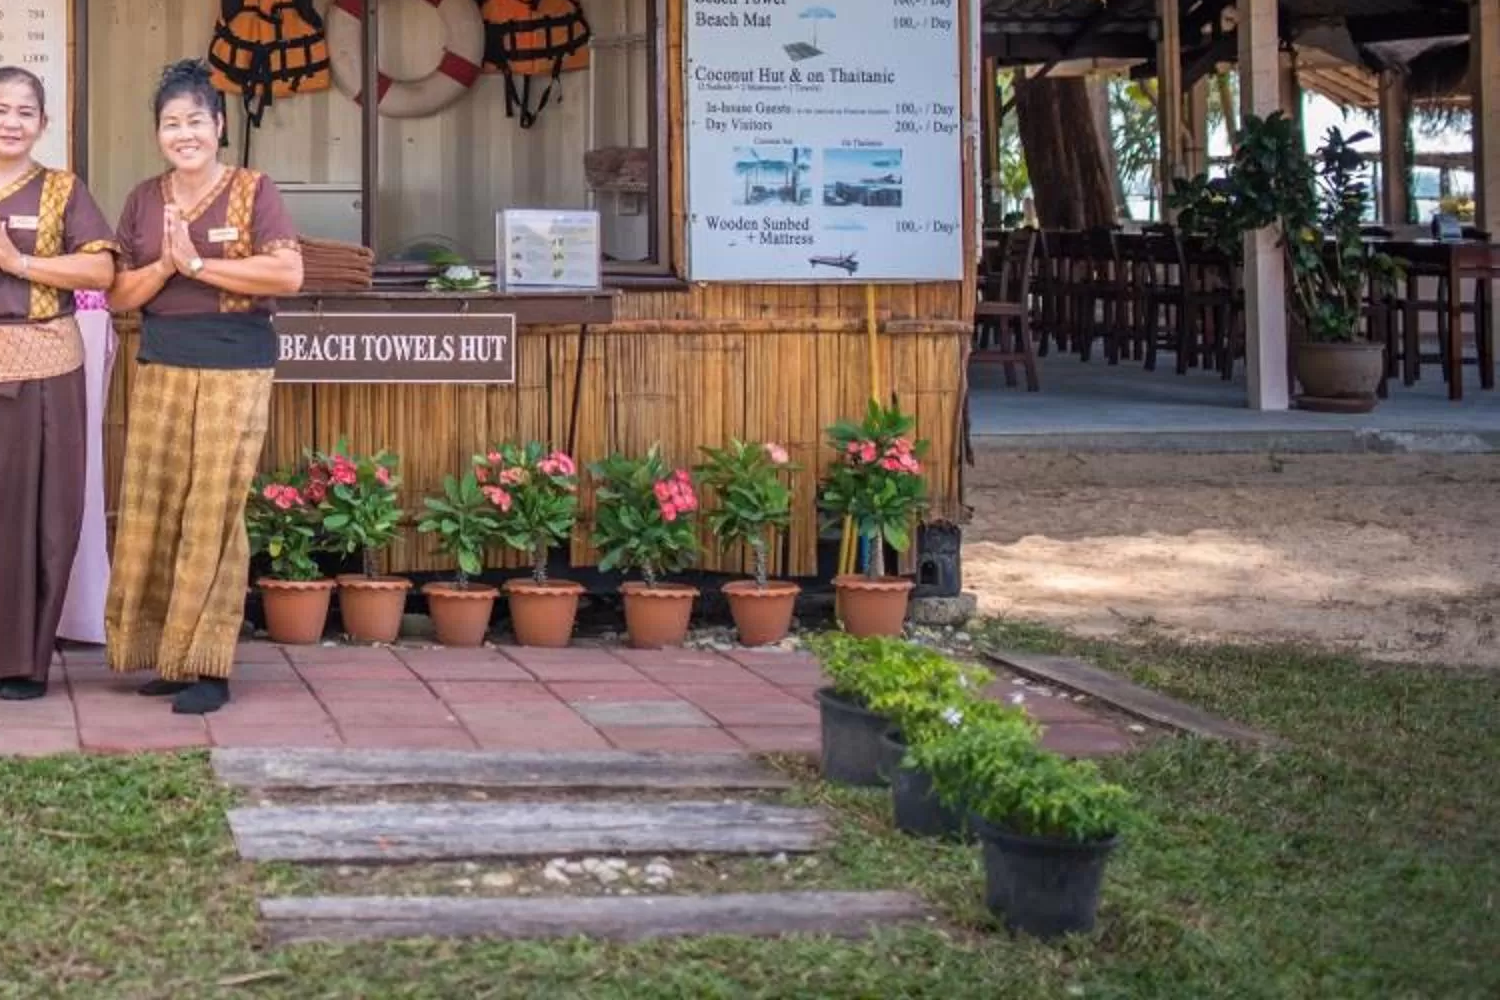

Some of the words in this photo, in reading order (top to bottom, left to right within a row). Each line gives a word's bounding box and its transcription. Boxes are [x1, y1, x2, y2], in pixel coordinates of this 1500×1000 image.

[695, 11, 739, 28] Beach
[743, 11, 771, 28] Mat
[930, 15, 952, 32] Day
[694, 66, 753, 82] Coconut
[758, 67, 785, 83] Hut
[789, 66, 803, 83] &
[807, 70, 825, 83] on
[828, 67, 895, 84] Thaitanic
[755, 101, 791, 114] Guests
[932, 103, 954, 118] Day
[705, 117, 728, 132] Day
[731, 116, 773, 132] Visitors
[933, 120, 955, 137] Day
[706, 215, 758, 231] Wooden
[762, 215, 810, 231] Sunbed
[933, 221, 955, 237] Day
[759, 230, 814, 246] Mattress
[278, 334, 357, 361] BEACH
[361, 334, 454, 361] TOWELS
[460, 335, 507, 361] HUT
